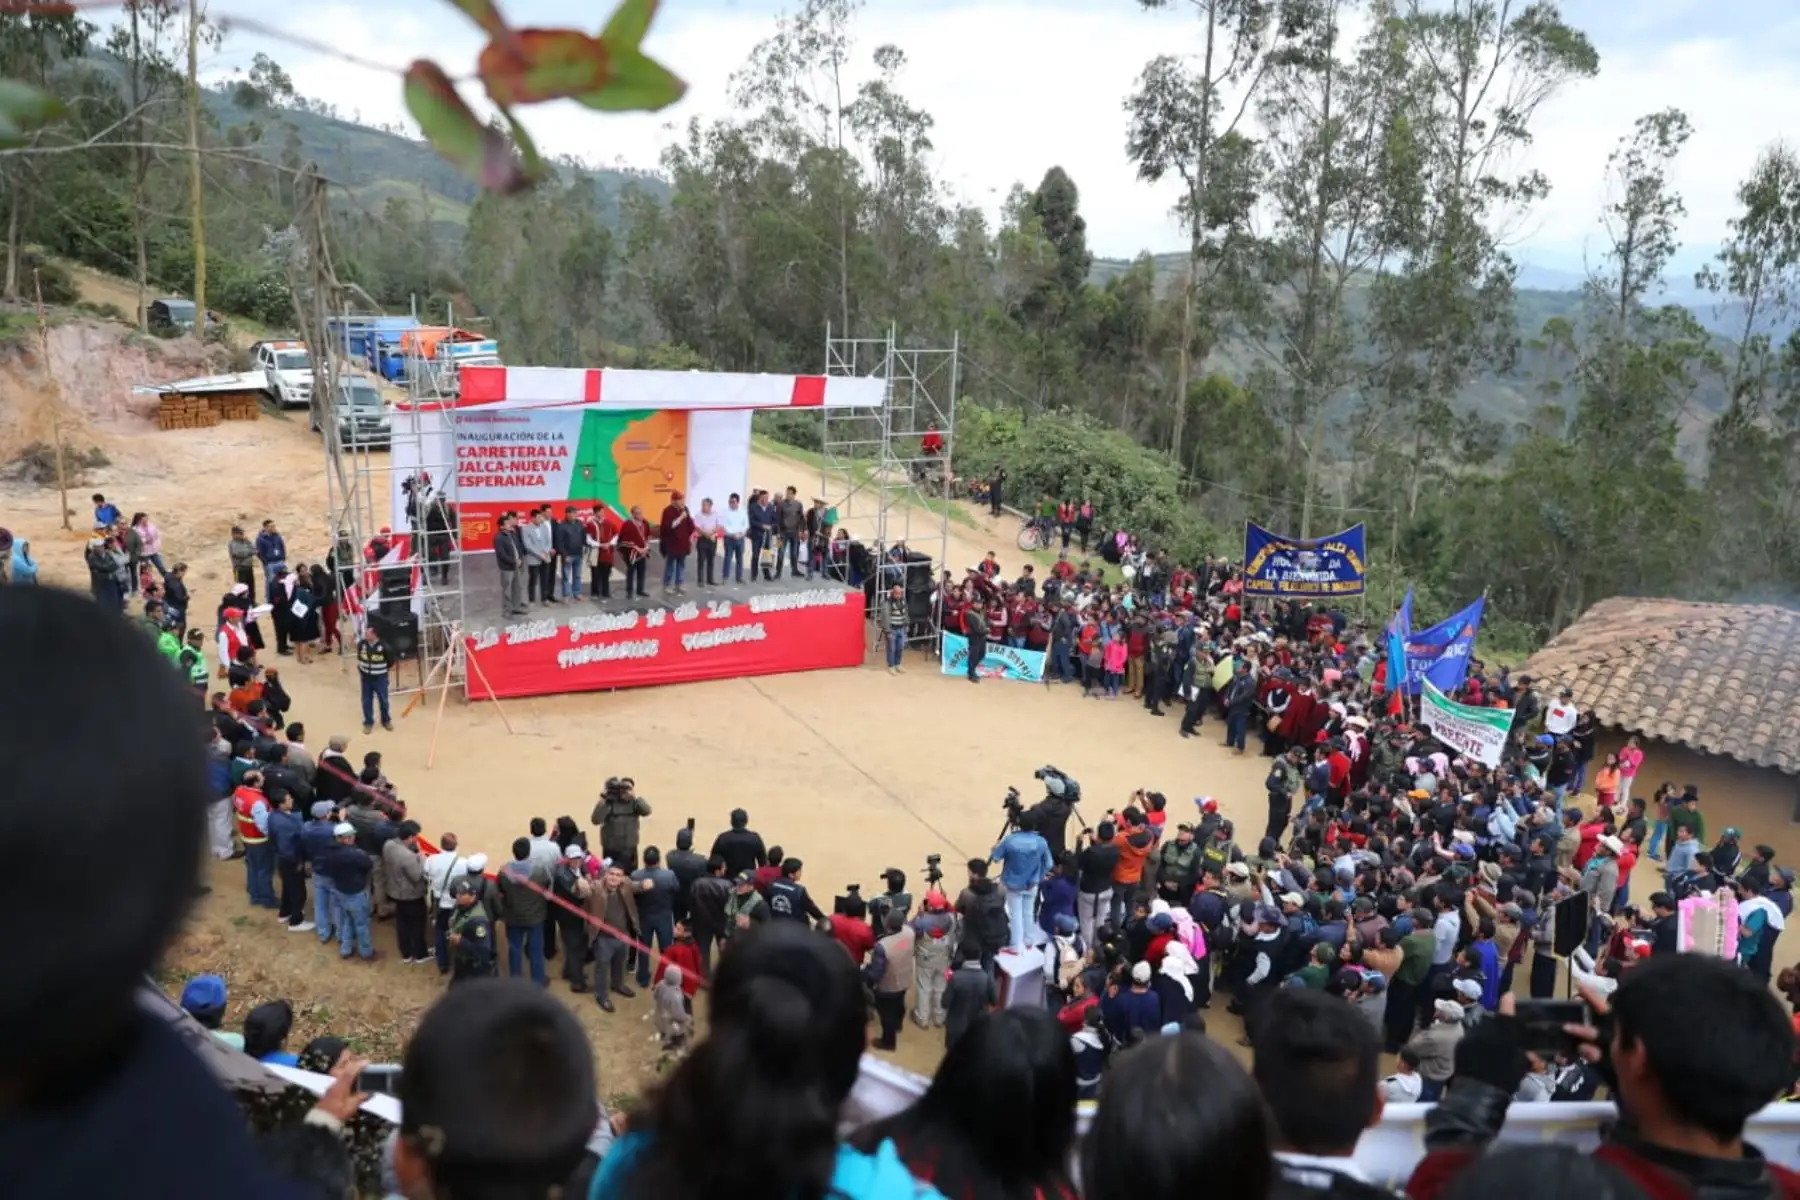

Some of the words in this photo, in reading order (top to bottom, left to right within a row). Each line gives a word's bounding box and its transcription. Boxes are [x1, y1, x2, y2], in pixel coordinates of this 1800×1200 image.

[536, 431, 549, 441] DE
[552, 431, 564, 441] LA
[457, 445, 546, 458] CARRETERA
[549, 445, 568, 457] LA
[458, 460, 561, 472] JALCA-NUEVA
[457, 475, 546, 487] ESPERANZA
